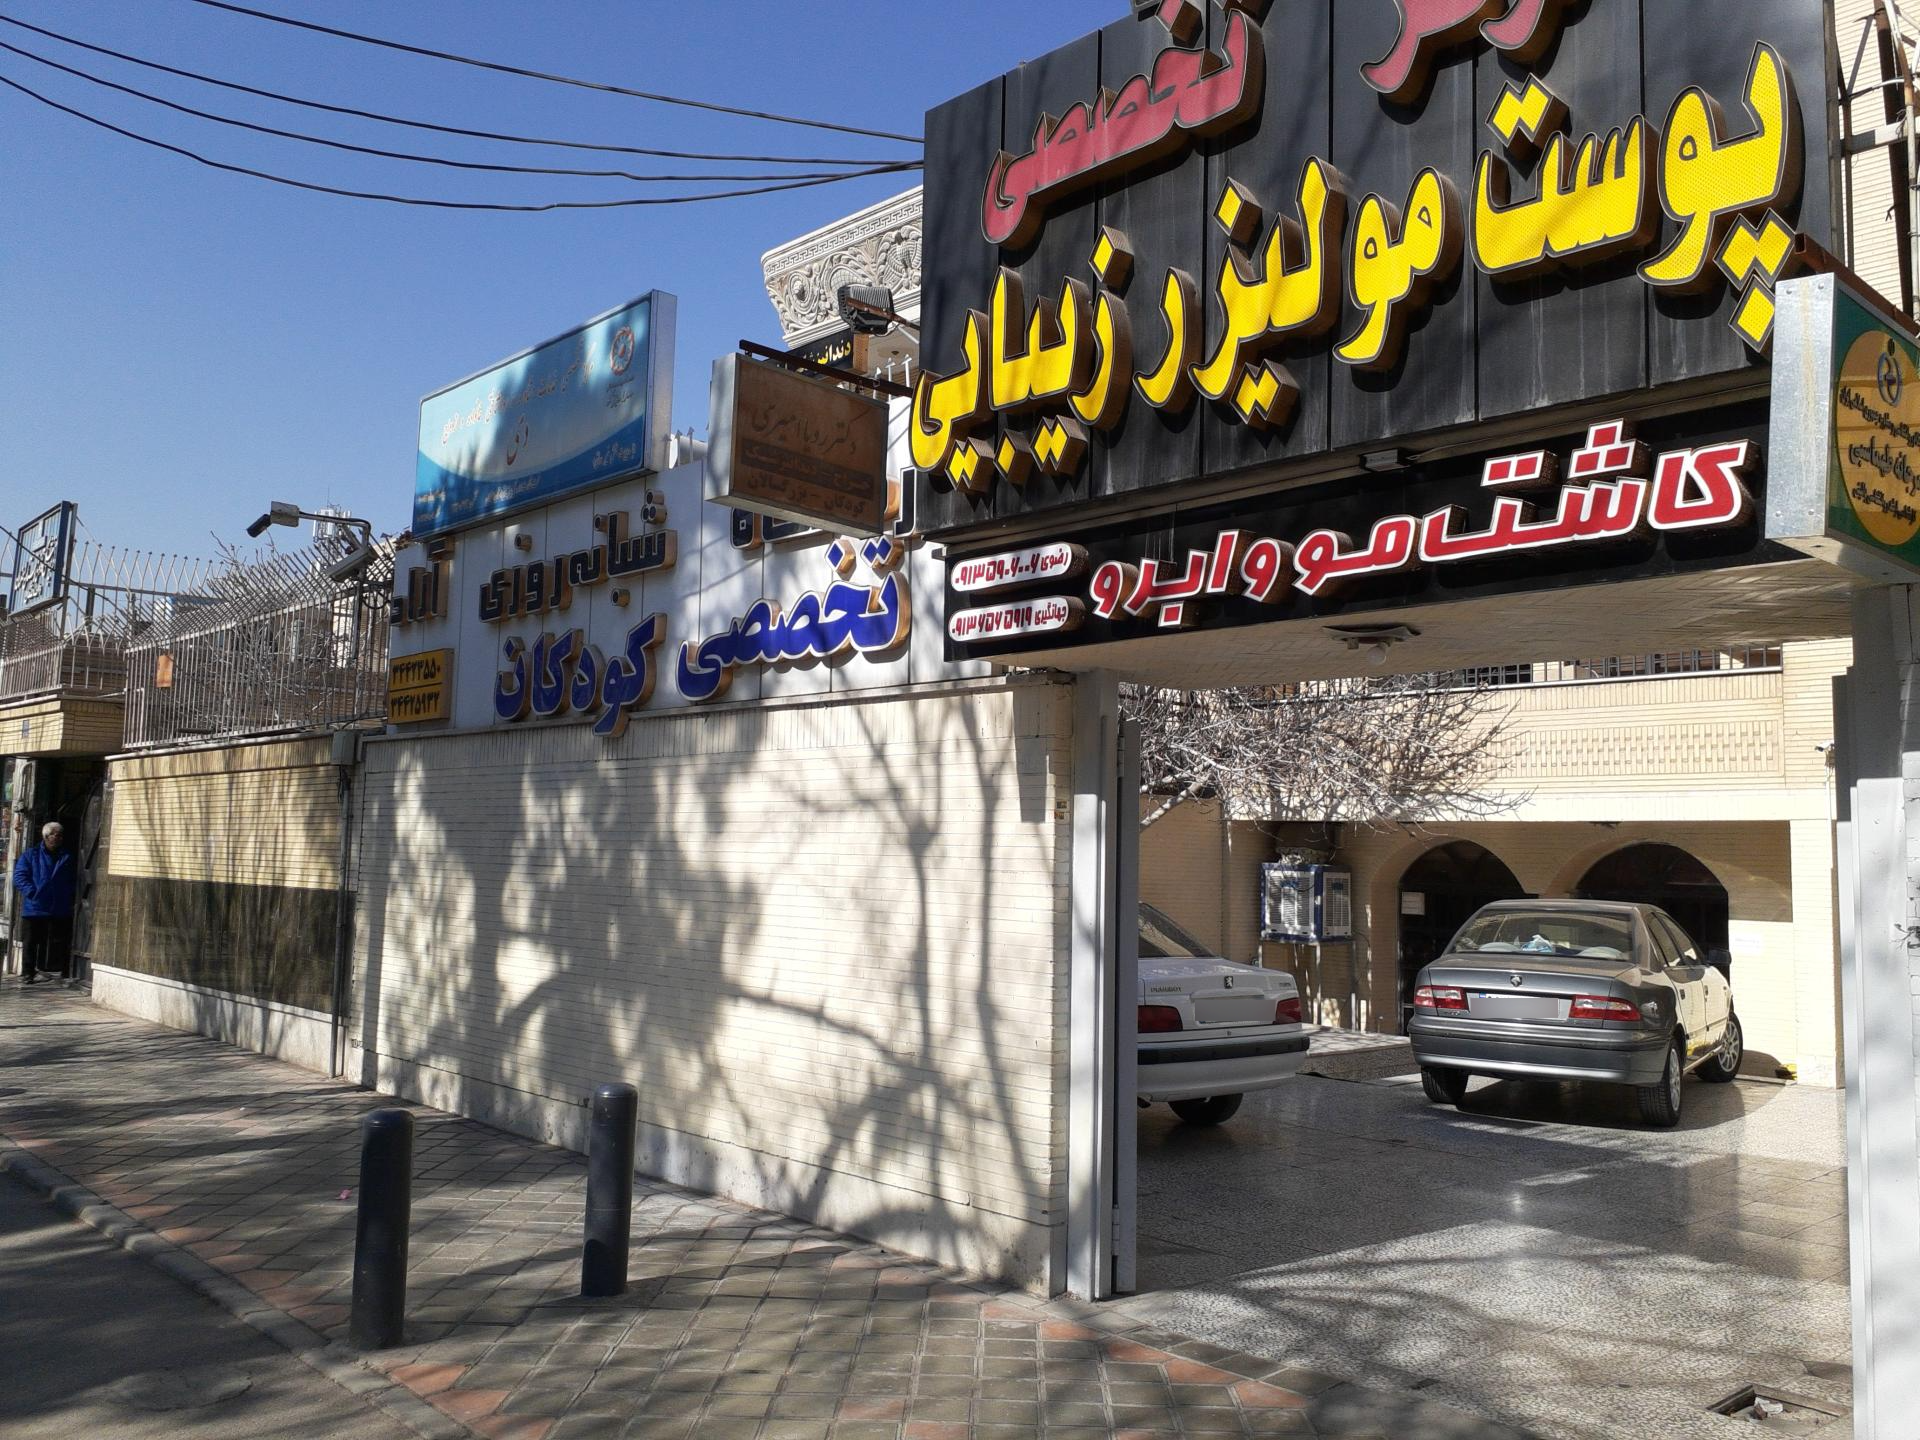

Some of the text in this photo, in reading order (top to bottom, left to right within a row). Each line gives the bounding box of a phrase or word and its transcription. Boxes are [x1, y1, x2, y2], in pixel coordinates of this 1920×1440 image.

[909, 41, 1796, 488] پوست مو لیزر زیبایی
[1034, 602, 1067, 626] جهانگیری
[1040, 548, 1069, 571] رضوی
[1089, 418, 1751, 628] کاشت مو و ابرو
[495, 535, 901, 737] تخصصی کودکان
